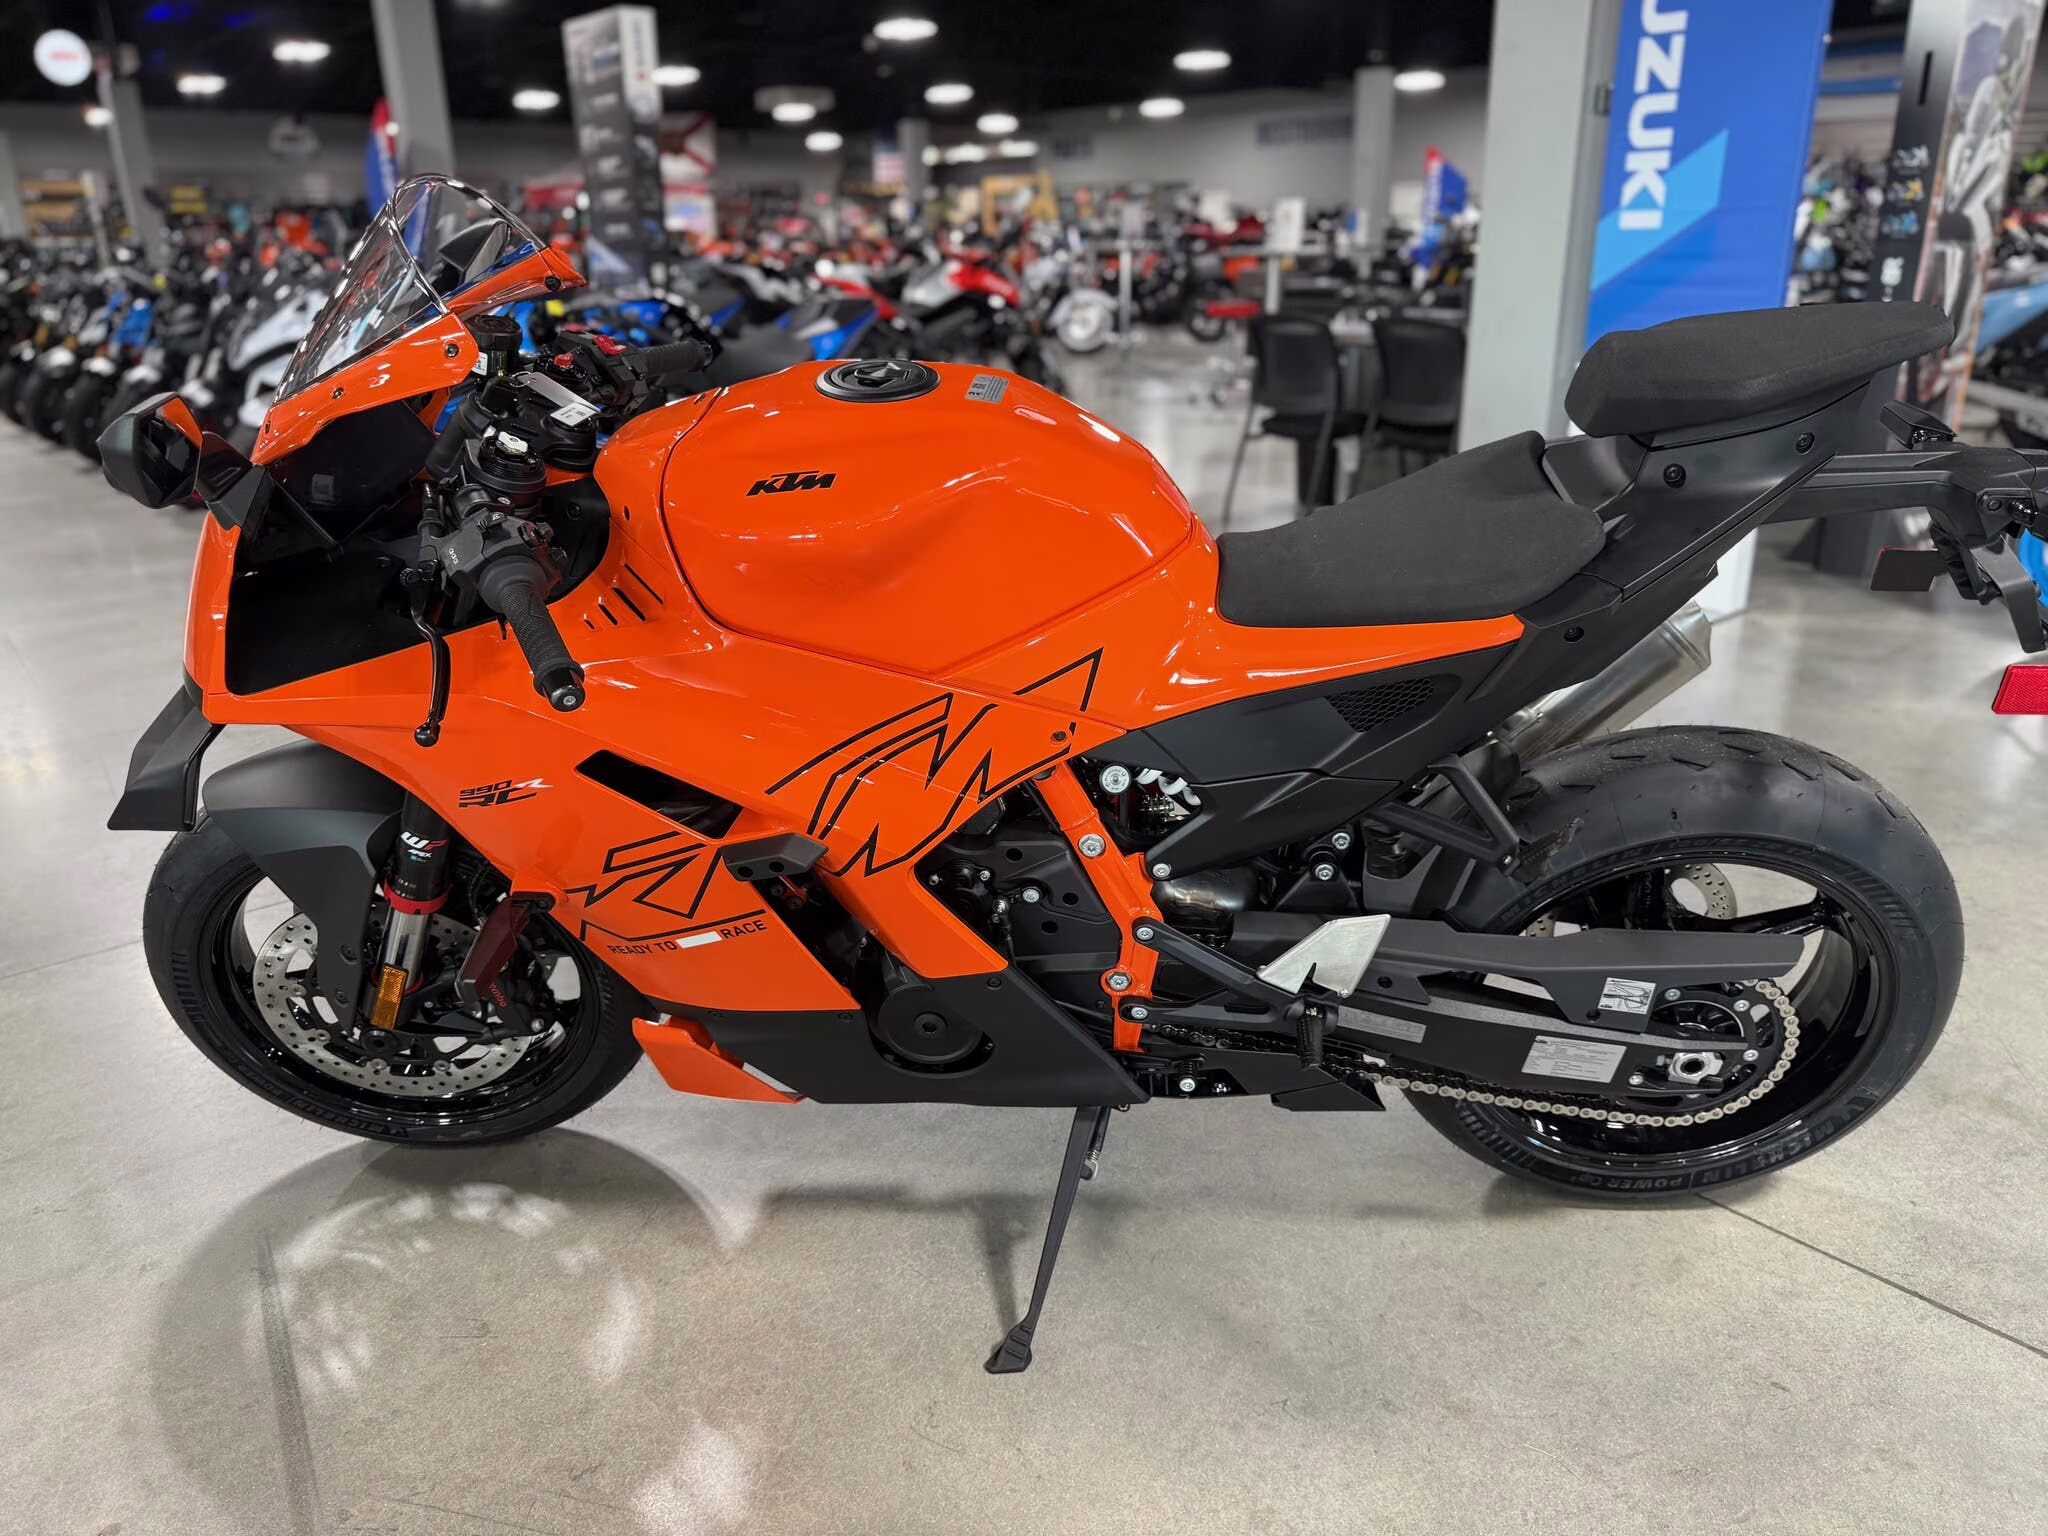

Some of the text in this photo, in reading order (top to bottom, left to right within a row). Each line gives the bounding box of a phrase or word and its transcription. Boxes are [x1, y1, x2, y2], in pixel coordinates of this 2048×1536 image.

[746, 470, 836, 496] KTM
[608, 920, 767, 955] READY TO RACE
[1607, 1176, 1683, 1189] POWER
